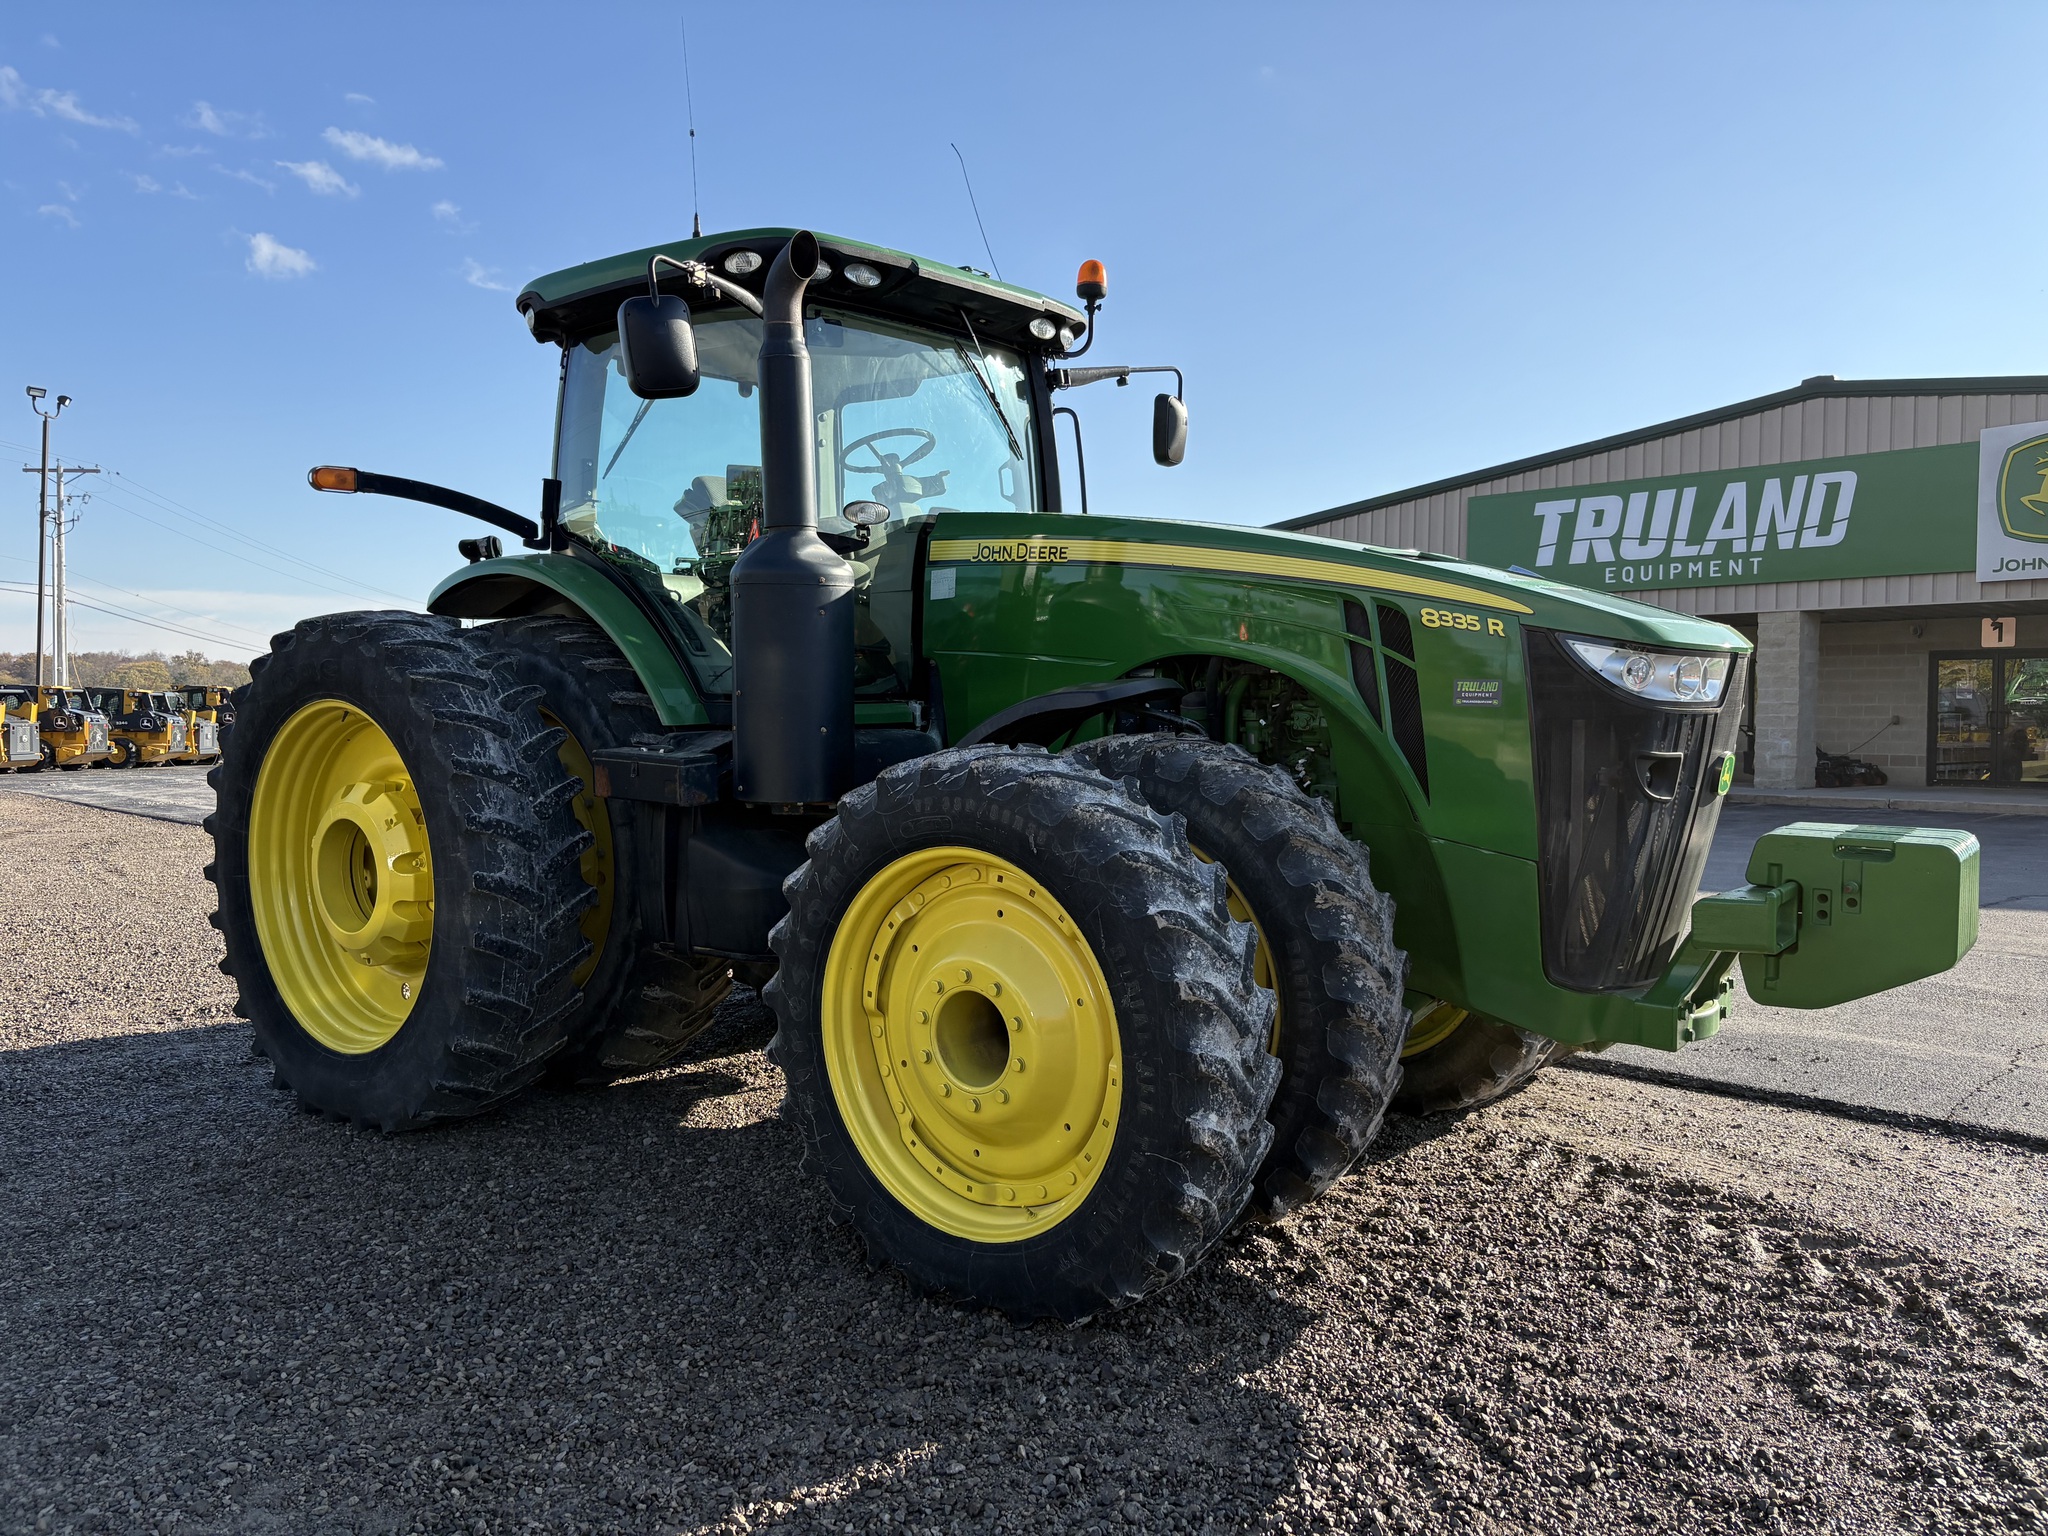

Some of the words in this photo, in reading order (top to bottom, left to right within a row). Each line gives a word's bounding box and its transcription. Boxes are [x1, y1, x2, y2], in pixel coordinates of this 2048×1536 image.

[1533, 470, 1858, 567] TRULAND
[972, 543, 1013, 560] JOHN
[1016, 543, 1069, 560] DEERE
[1605, 557, 1763, 584] EQUIPMENT
[1420, 607, 1481, 632] 8335
[1486, 617, 1506, 637] R
[1456, 681, 1499, 692] TRULAND
